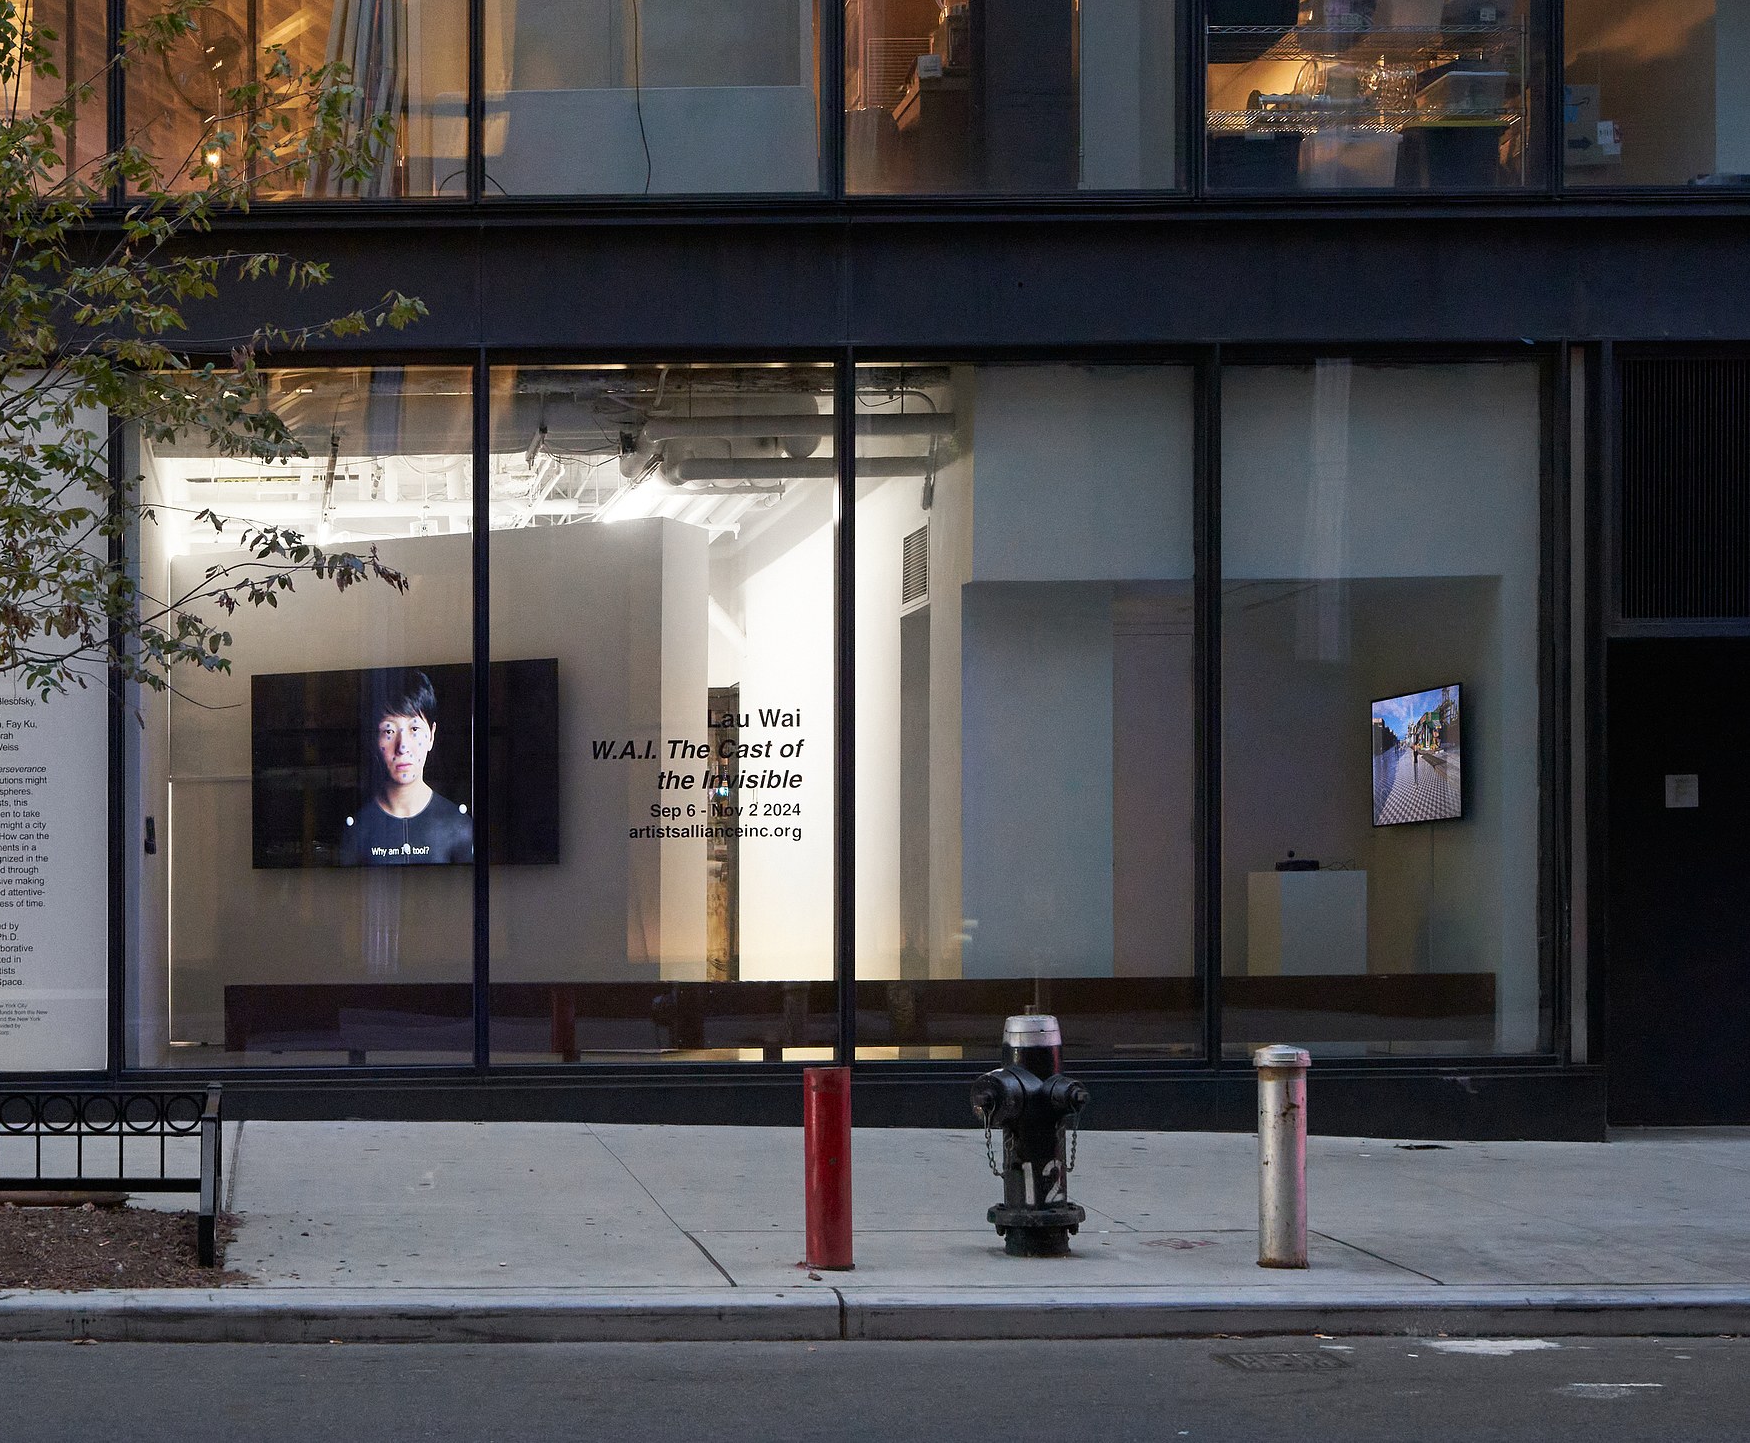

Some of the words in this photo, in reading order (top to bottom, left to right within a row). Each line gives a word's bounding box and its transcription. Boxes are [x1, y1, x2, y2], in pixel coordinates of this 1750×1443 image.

[7, 720, 21, 728] Fay
[24, 720, 37, 728] Ku,
[707, 710, 749, 727] Lau
[759, 709, 801, 727] Wai
[592, 741, 656, 759] W.A.I.
[667, 740, 710, 759] The
[718, 739, 772, 758] Cast
[780, 739, 804, 758] of
[658, 771, 694, 789] the
[702, 770, 802, 789] Invisible
[651, 804, 681, 820] Sep
[687, 804, 695, 817] 6
[712, 804, 743, 817] Nov
[749, 804, 757, 816] 2
[763, 804, 801, 816] 2024
[629, 825, 802, 841] artistsallianceinc.org
[371, 847, 387, 857] Why
[413, 846, 429, 854] tool?
[1022, 1159, 1065, 1204] 12
